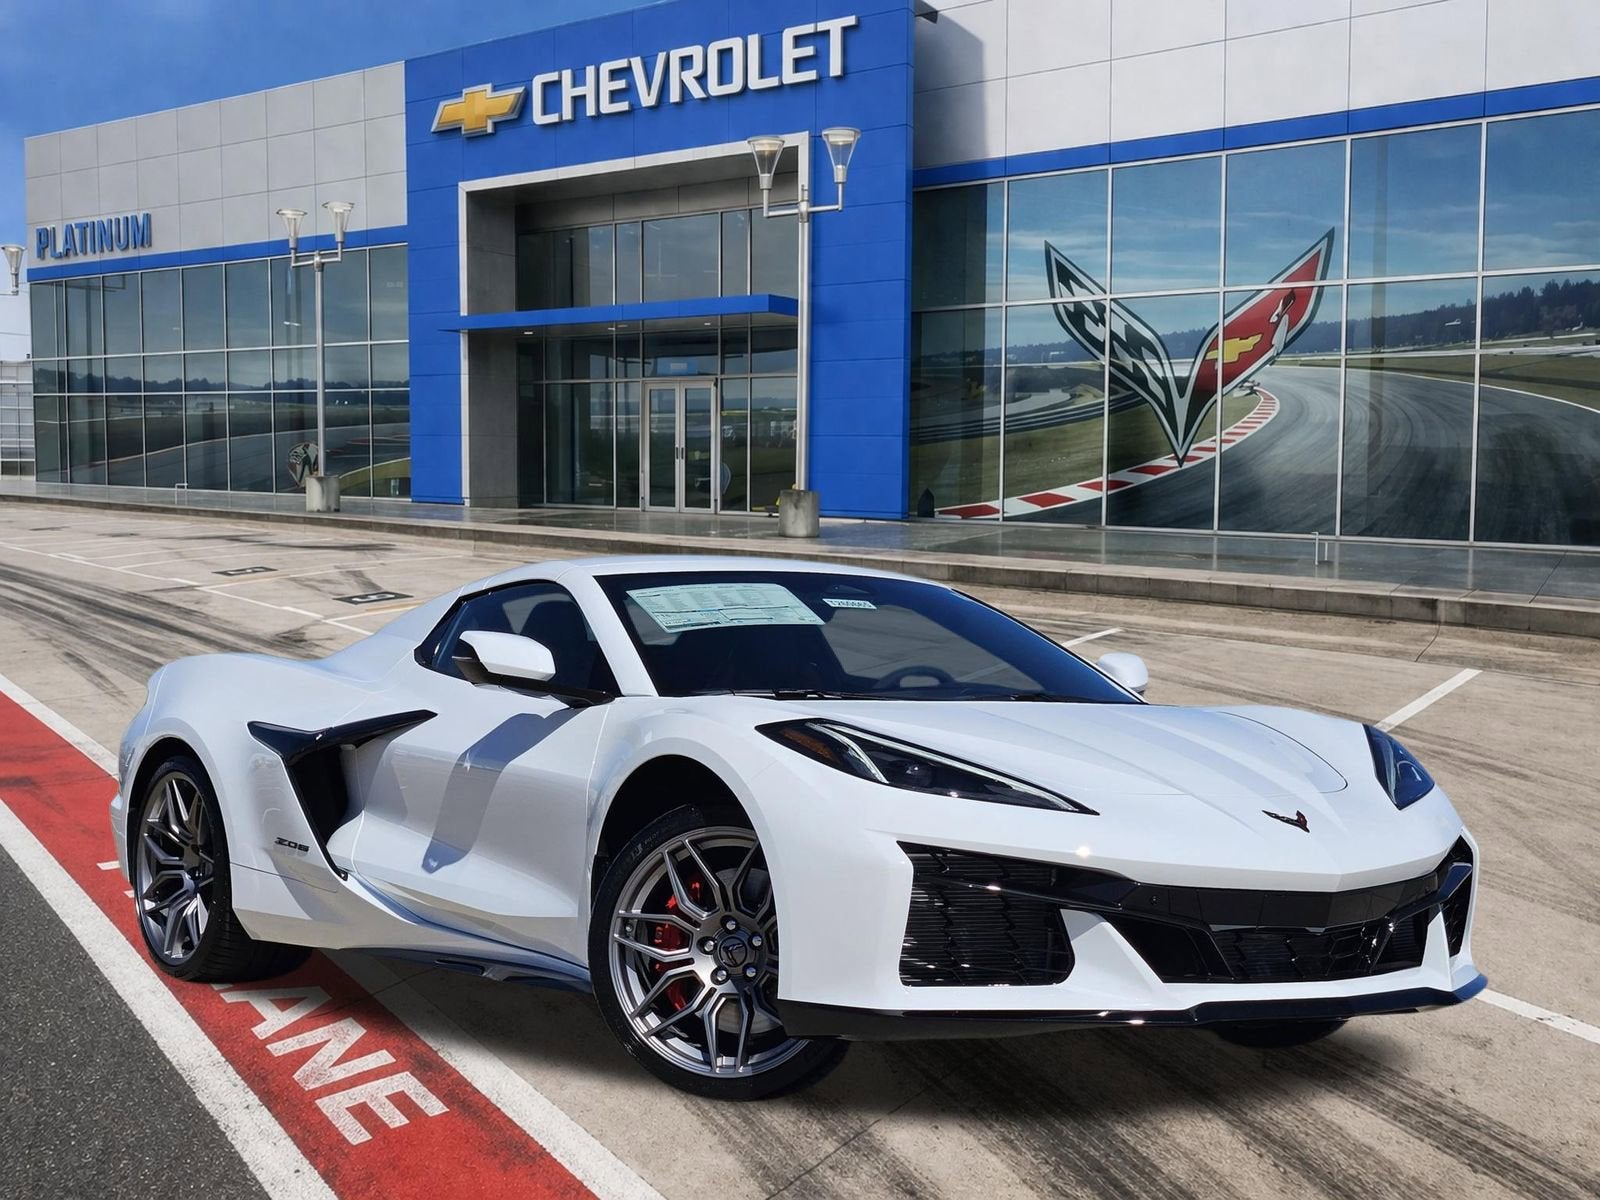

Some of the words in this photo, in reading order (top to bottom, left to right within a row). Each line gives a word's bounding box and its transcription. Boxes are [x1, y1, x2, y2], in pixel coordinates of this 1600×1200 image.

[532, 15, 859, 126] CHEVROLET
[36, 212, 152, 260] PLATINUM
[274, 836, 310, 853] Z06
[209, 983, 450, 1146] ANE
